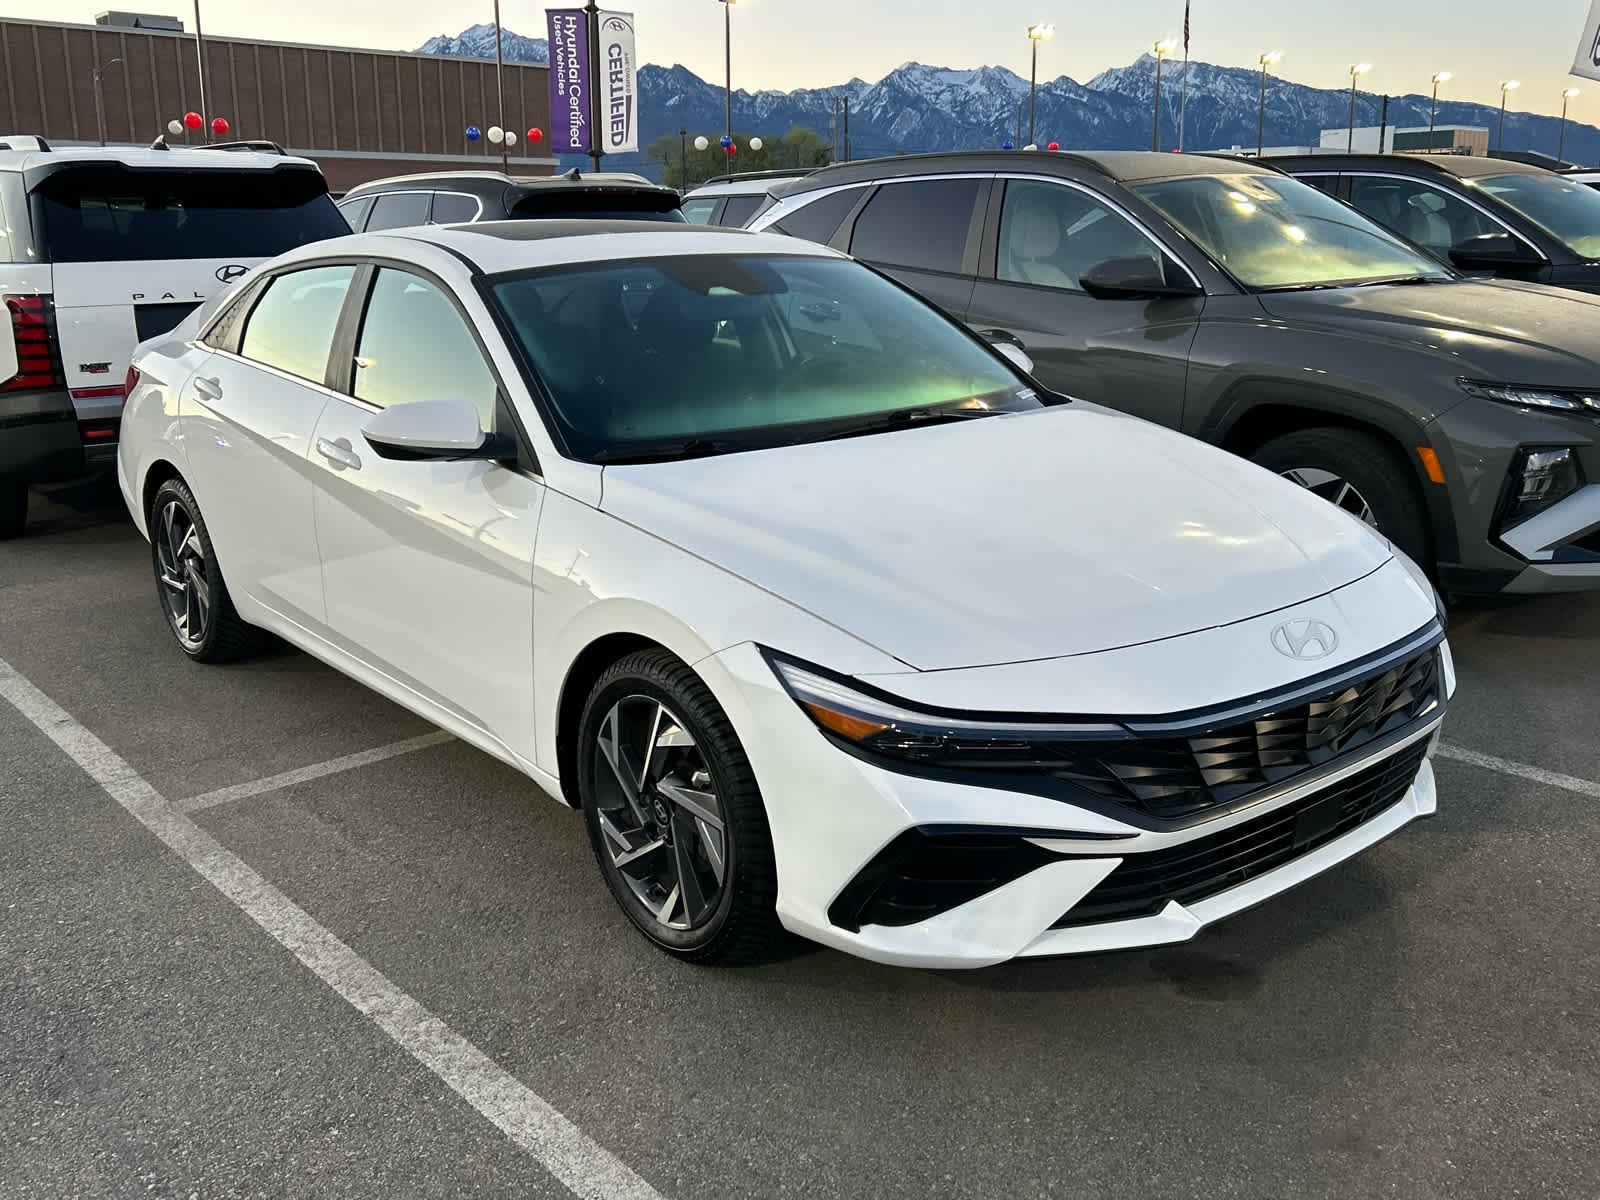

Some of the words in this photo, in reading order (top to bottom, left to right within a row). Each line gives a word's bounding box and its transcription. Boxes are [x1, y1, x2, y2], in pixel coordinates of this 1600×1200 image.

[553, 15, 563, 45] Used
[564, 16, 580, 83] Hyundai
[556, 47, 566, 96] Vehicles
[569, 84, 585, 148] Certified
